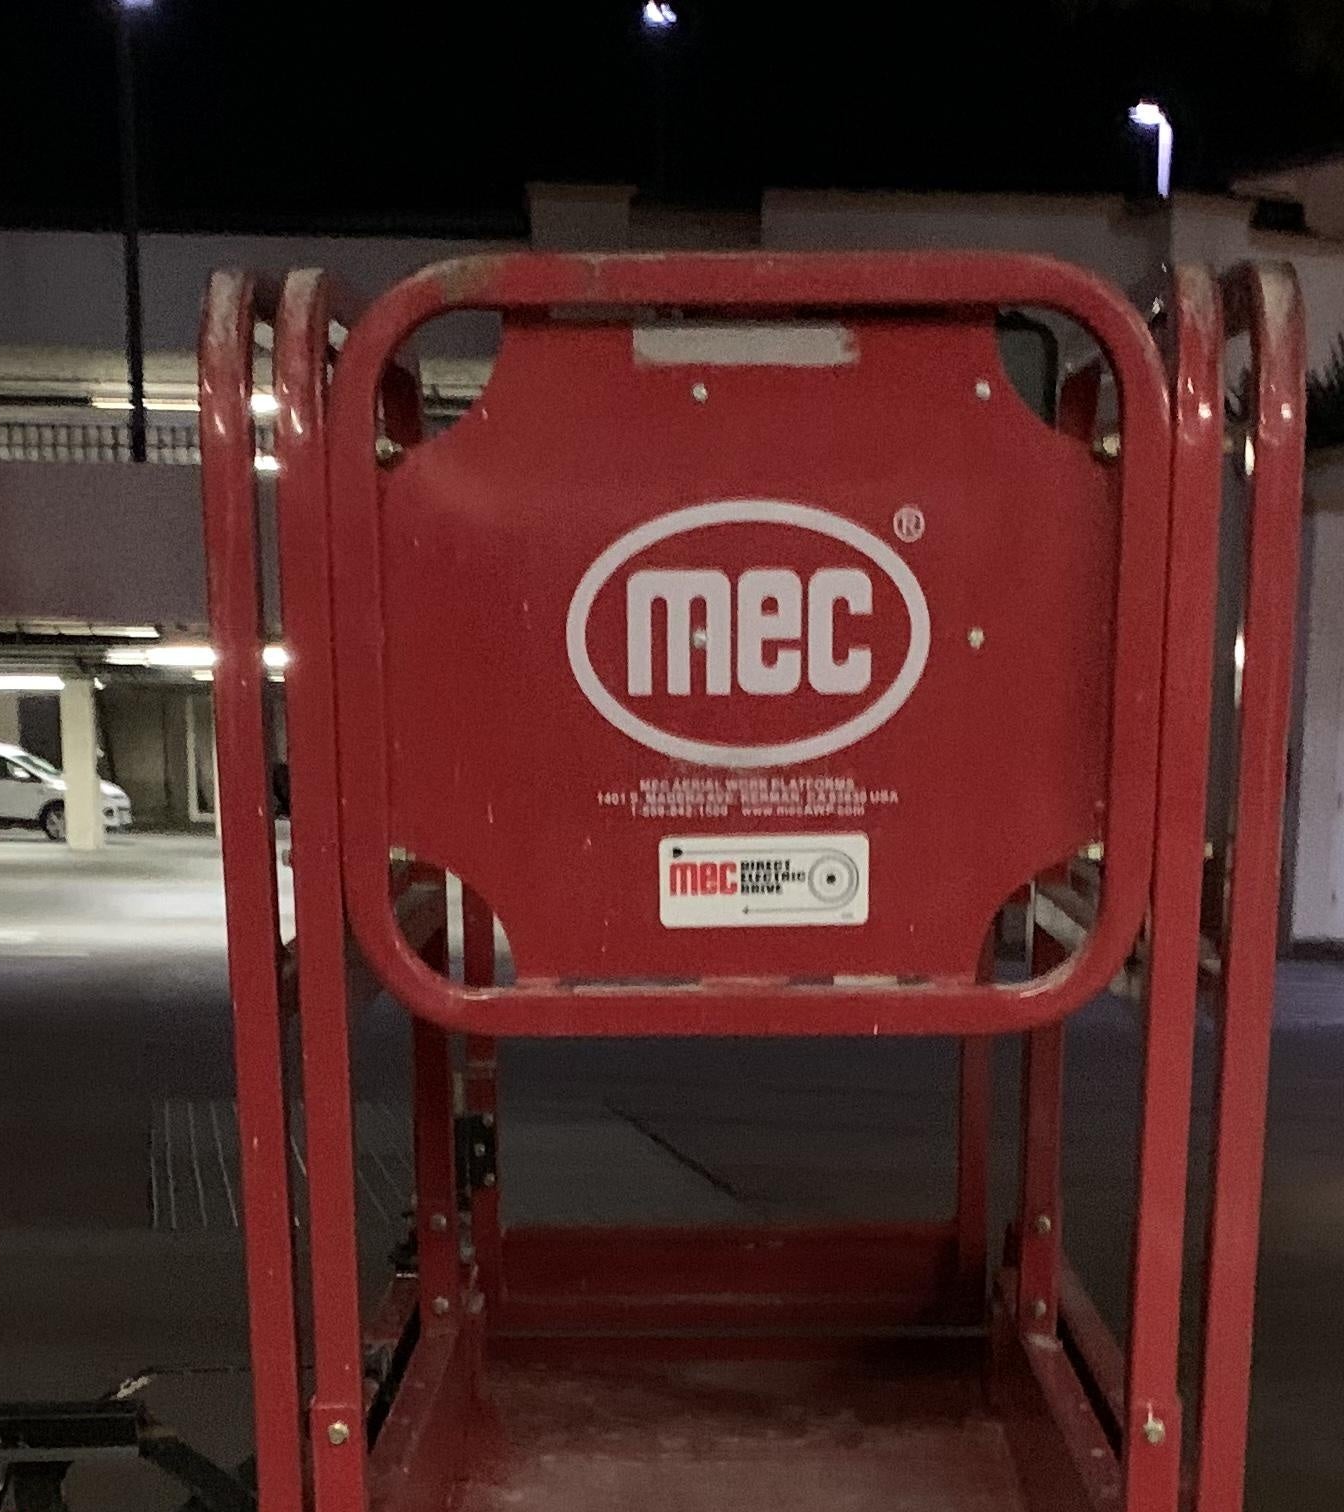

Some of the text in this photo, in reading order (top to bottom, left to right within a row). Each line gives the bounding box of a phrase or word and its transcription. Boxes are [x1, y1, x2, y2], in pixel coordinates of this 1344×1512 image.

[672, 779, 720, 792] AERIAL
[725, 779, 768, 792] WORK
[771, 778, 854, 792] PLATFORMS
[597, 791, 626, 805] 1401
[741, 860, 790, 871] DIRECT
[741, 871, 805, 883] ELECTRIC
[741, 884, 783, 895] DRIVE
